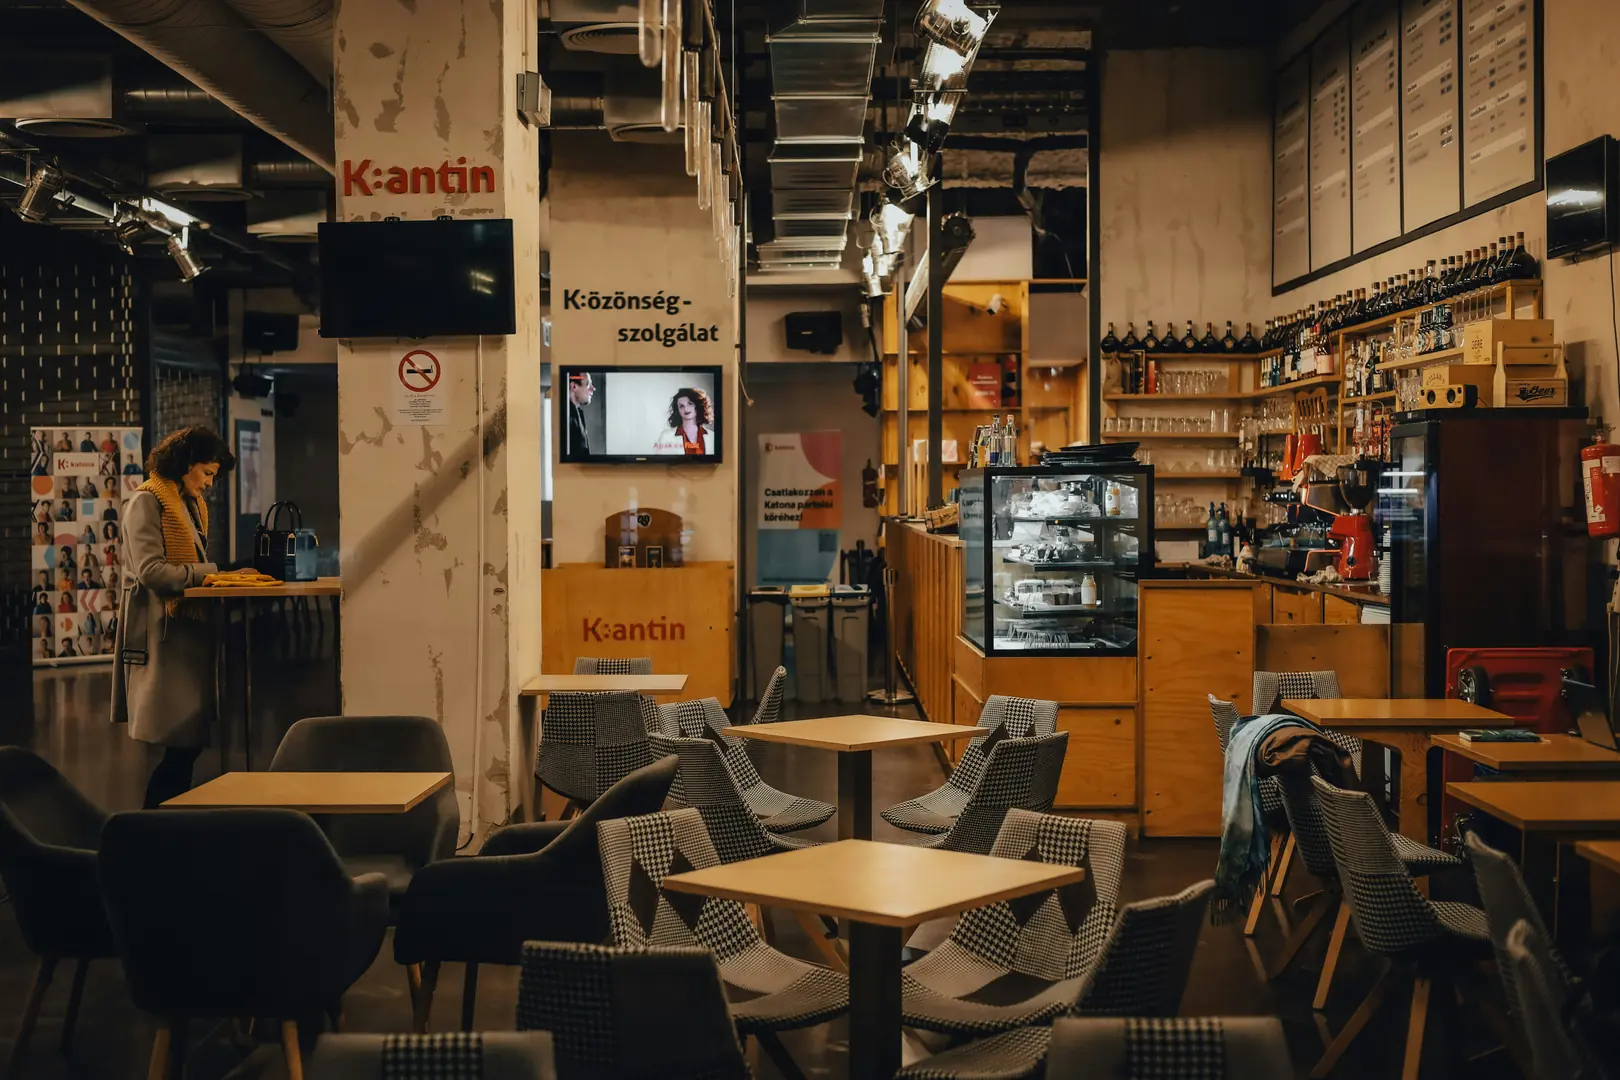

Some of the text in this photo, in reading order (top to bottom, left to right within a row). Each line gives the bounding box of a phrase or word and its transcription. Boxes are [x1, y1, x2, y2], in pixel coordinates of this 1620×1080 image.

[343, 156, 495, 197] K:antin
[564, 289, 692, 315] K:özönség-
[618, 323, 719, 348] szolgálat
[764, 488, 825, 497] Csatlakozzon
[764, 500, 796, 509] Katona
[583, 615, 686, 642] K:antin
